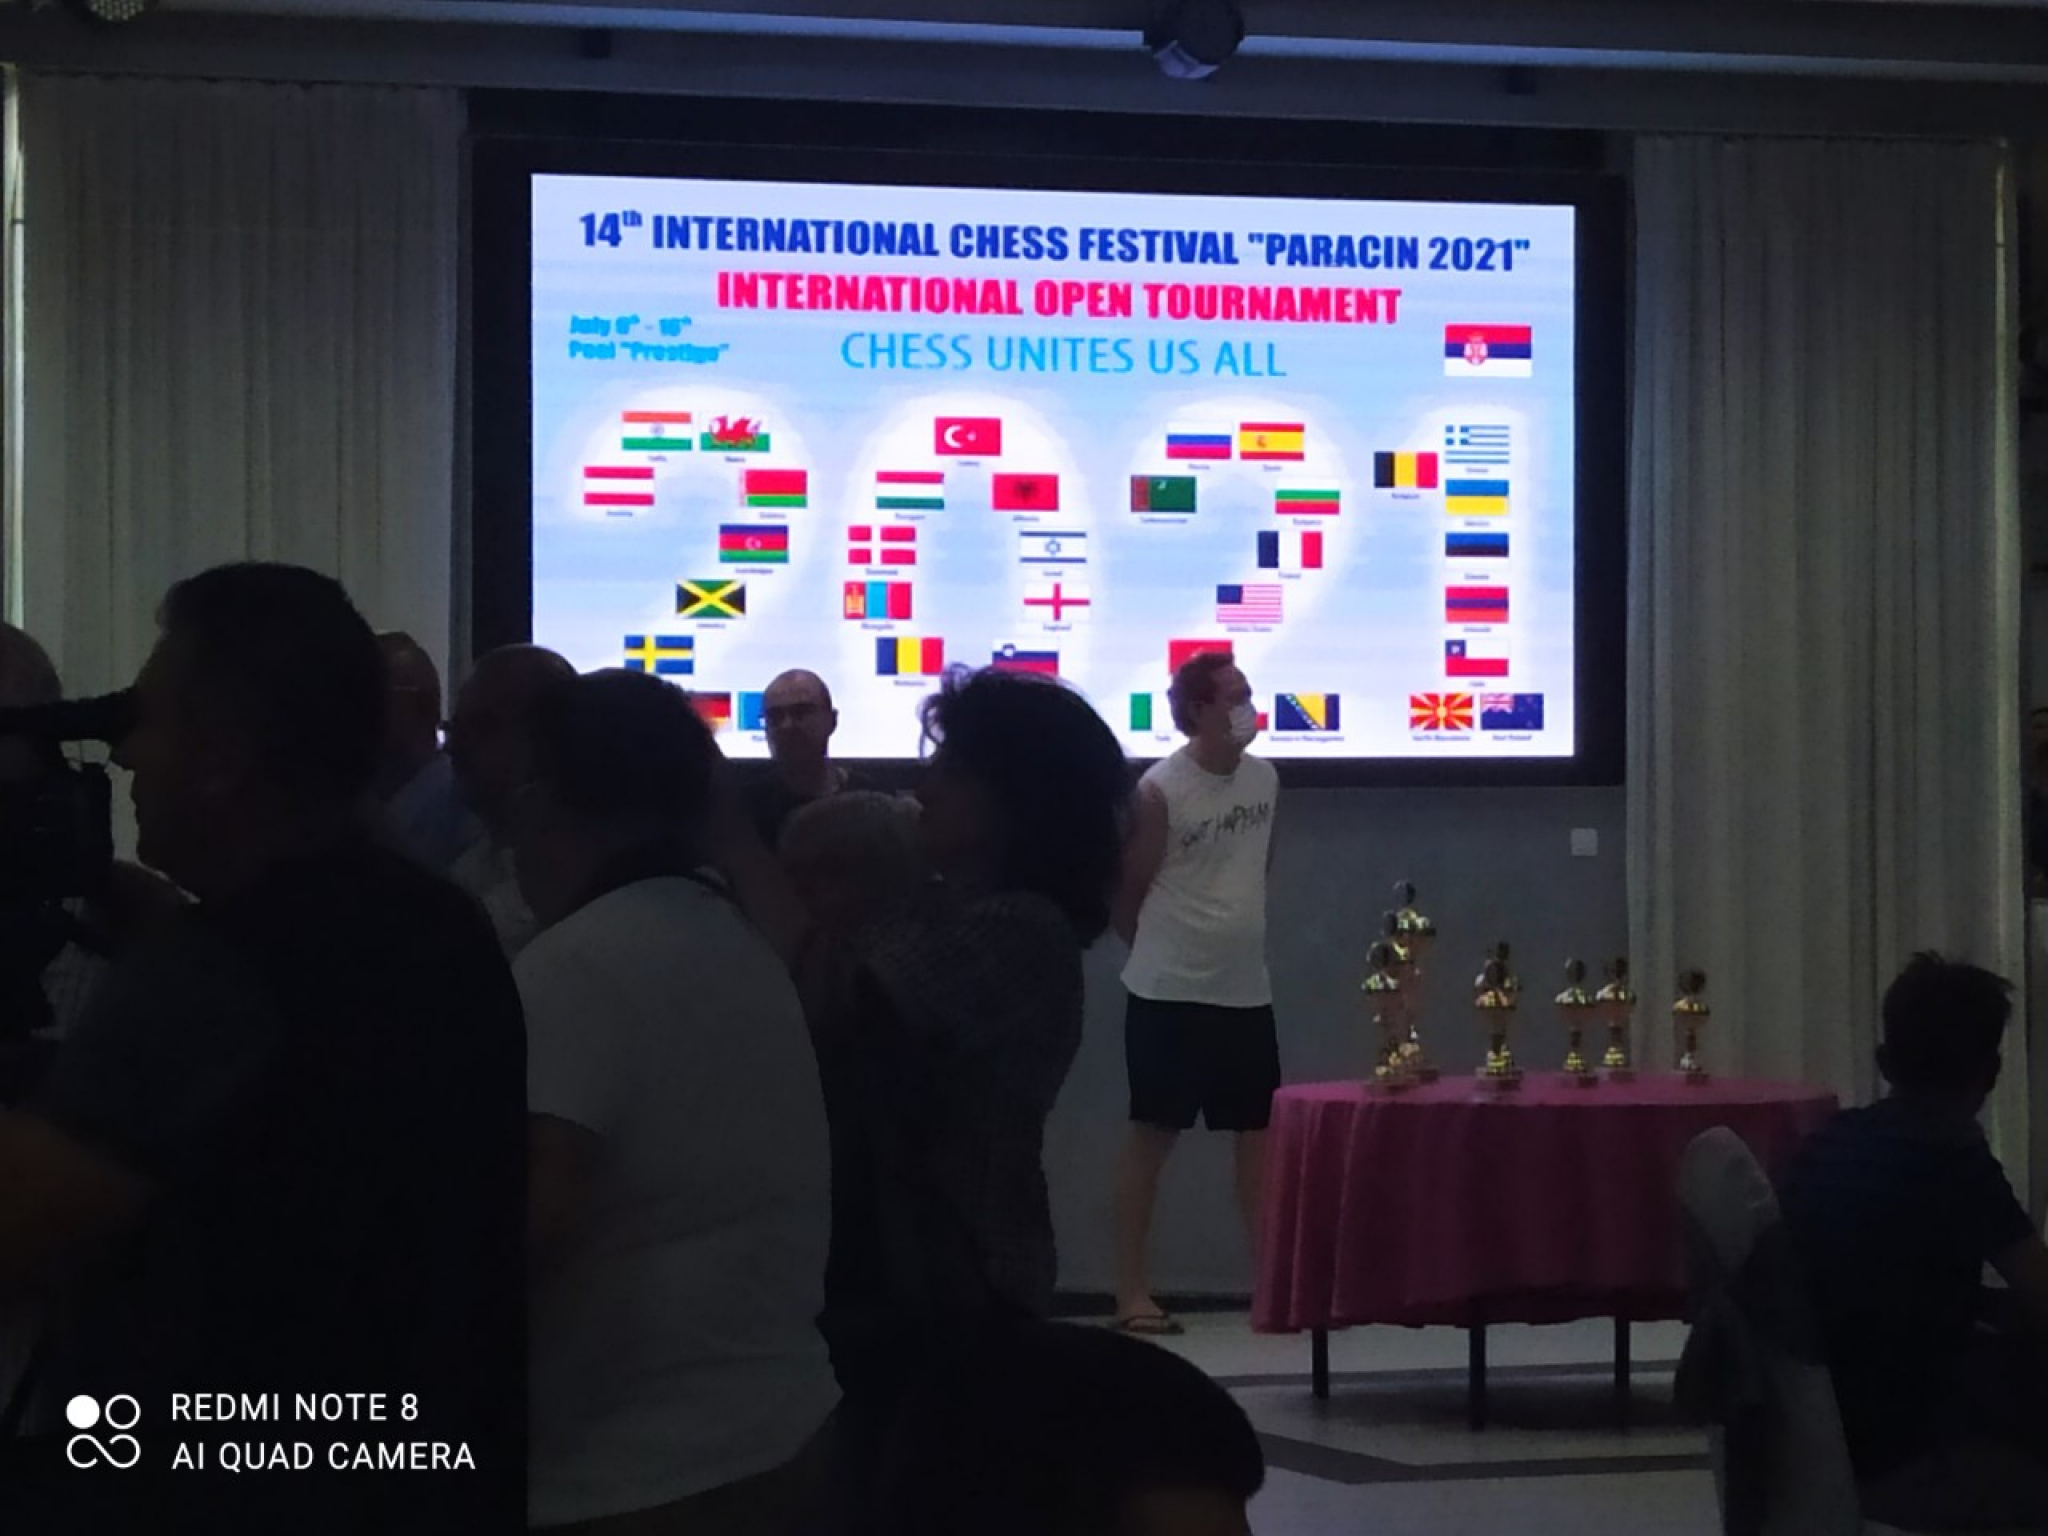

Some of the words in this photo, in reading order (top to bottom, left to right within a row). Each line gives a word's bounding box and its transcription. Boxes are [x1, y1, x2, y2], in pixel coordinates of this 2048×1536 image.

[579, 209, 643, 248] 14th
[652, 214, 940, 257] INTERNATIONAL
[949, 222, 1068, 262] CHESS
[1078, 226, 1240, 265] FESTIVAL
[1247, 231, 1420, 270] "PARACIN
[1428, 236, 1531, 272] 2021"
[717, 271, 1024, 316] INTERNATIONAL
[1034, 279, 1132, 318] OPEN
[1142, 282, 1402, 324] TOURNAMENT
[840, 331, 973, 371] CHESS
[986, 334, 1134, 374] UNITES
[1147, 338, 1200, 376] US
[1212, 340, 1288, 377] ALL
